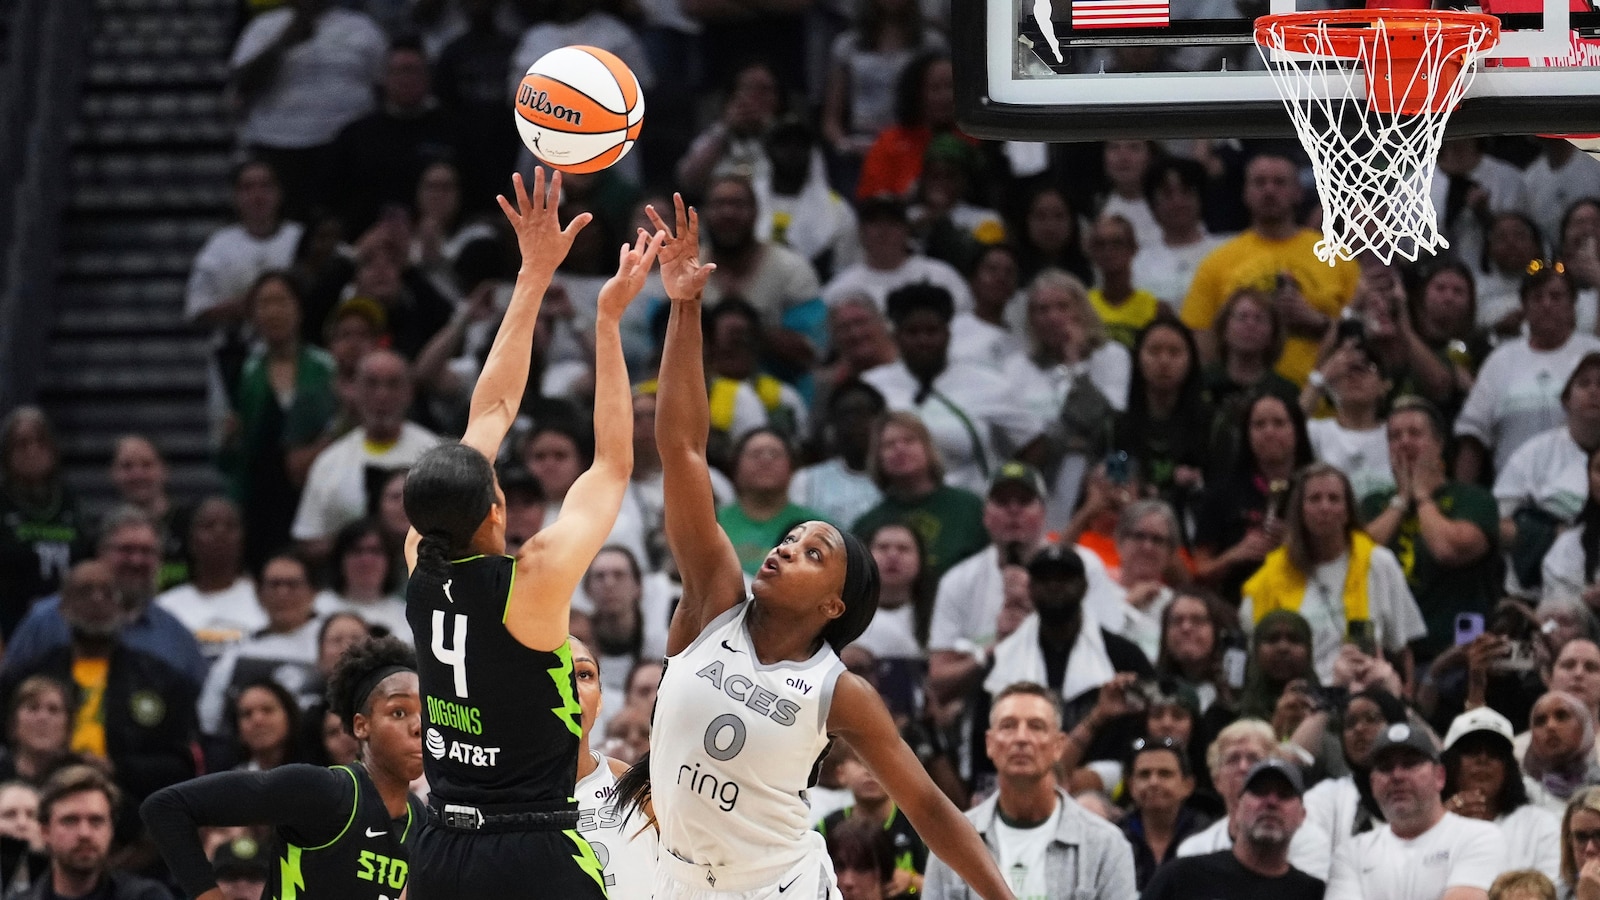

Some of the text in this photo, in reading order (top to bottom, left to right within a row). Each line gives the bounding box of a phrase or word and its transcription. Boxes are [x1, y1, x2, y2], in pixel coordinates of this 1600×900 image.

[518, 83, 582, 126] Wilson
[431, 609, 468, 698] 4
[695, 660, 801, 727] ACES
[786, 677, 813, 695] ally
[427, 695, 483, 735] DIGGINS
[449, 740, 500, 767] AT&T
[703, 713, 747, 761] 0
[677, 762, 739, 812] ring
[576, 804, 622, 833] ES
[356, 849, 409, 890] STO
